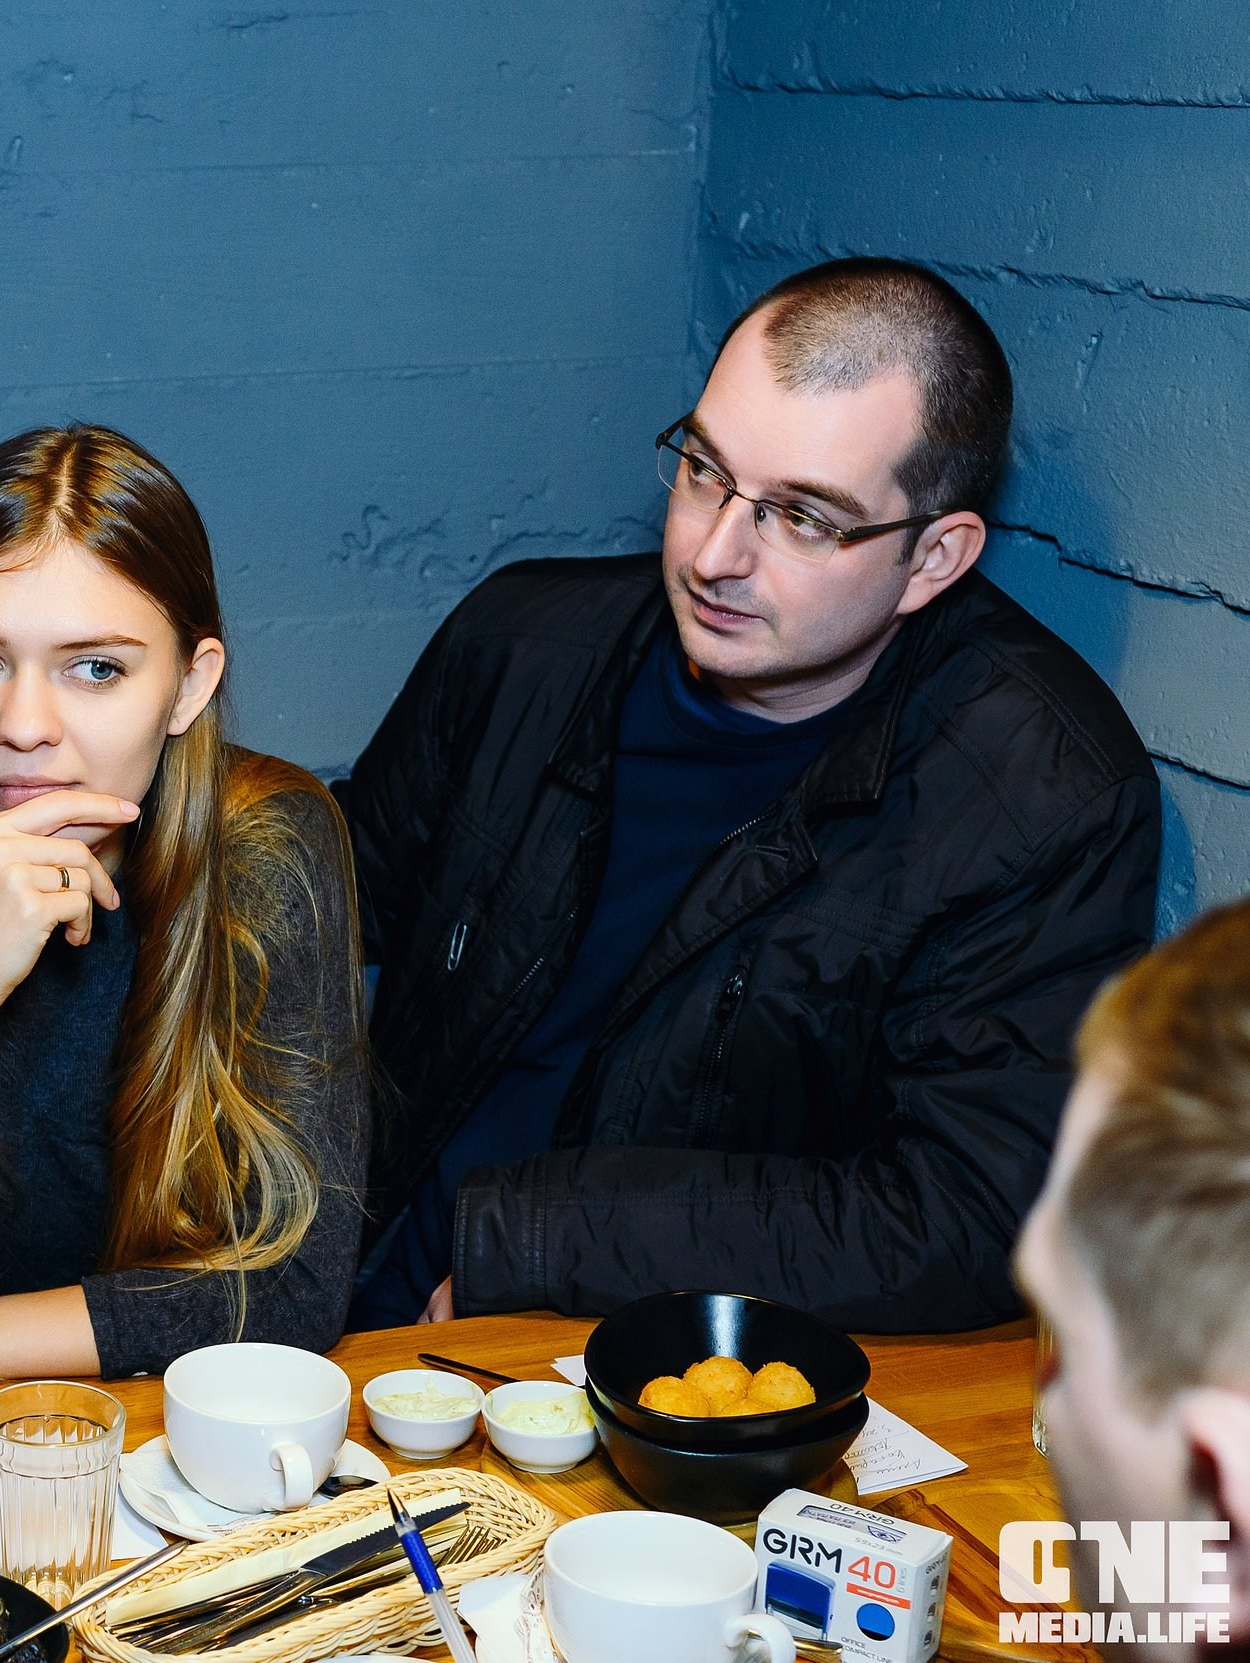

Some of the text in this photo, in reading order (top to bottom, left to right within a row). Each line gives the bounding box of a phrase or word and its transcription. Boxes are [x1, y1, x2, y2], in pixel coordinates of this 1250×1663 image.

[763, 1528, 842, 1573] GRM
[848, 1556, 896, 1589] 40
[841, 1636, 866, 1649] OFFICE
[844, 1645, 875, 1659] OMPACT
